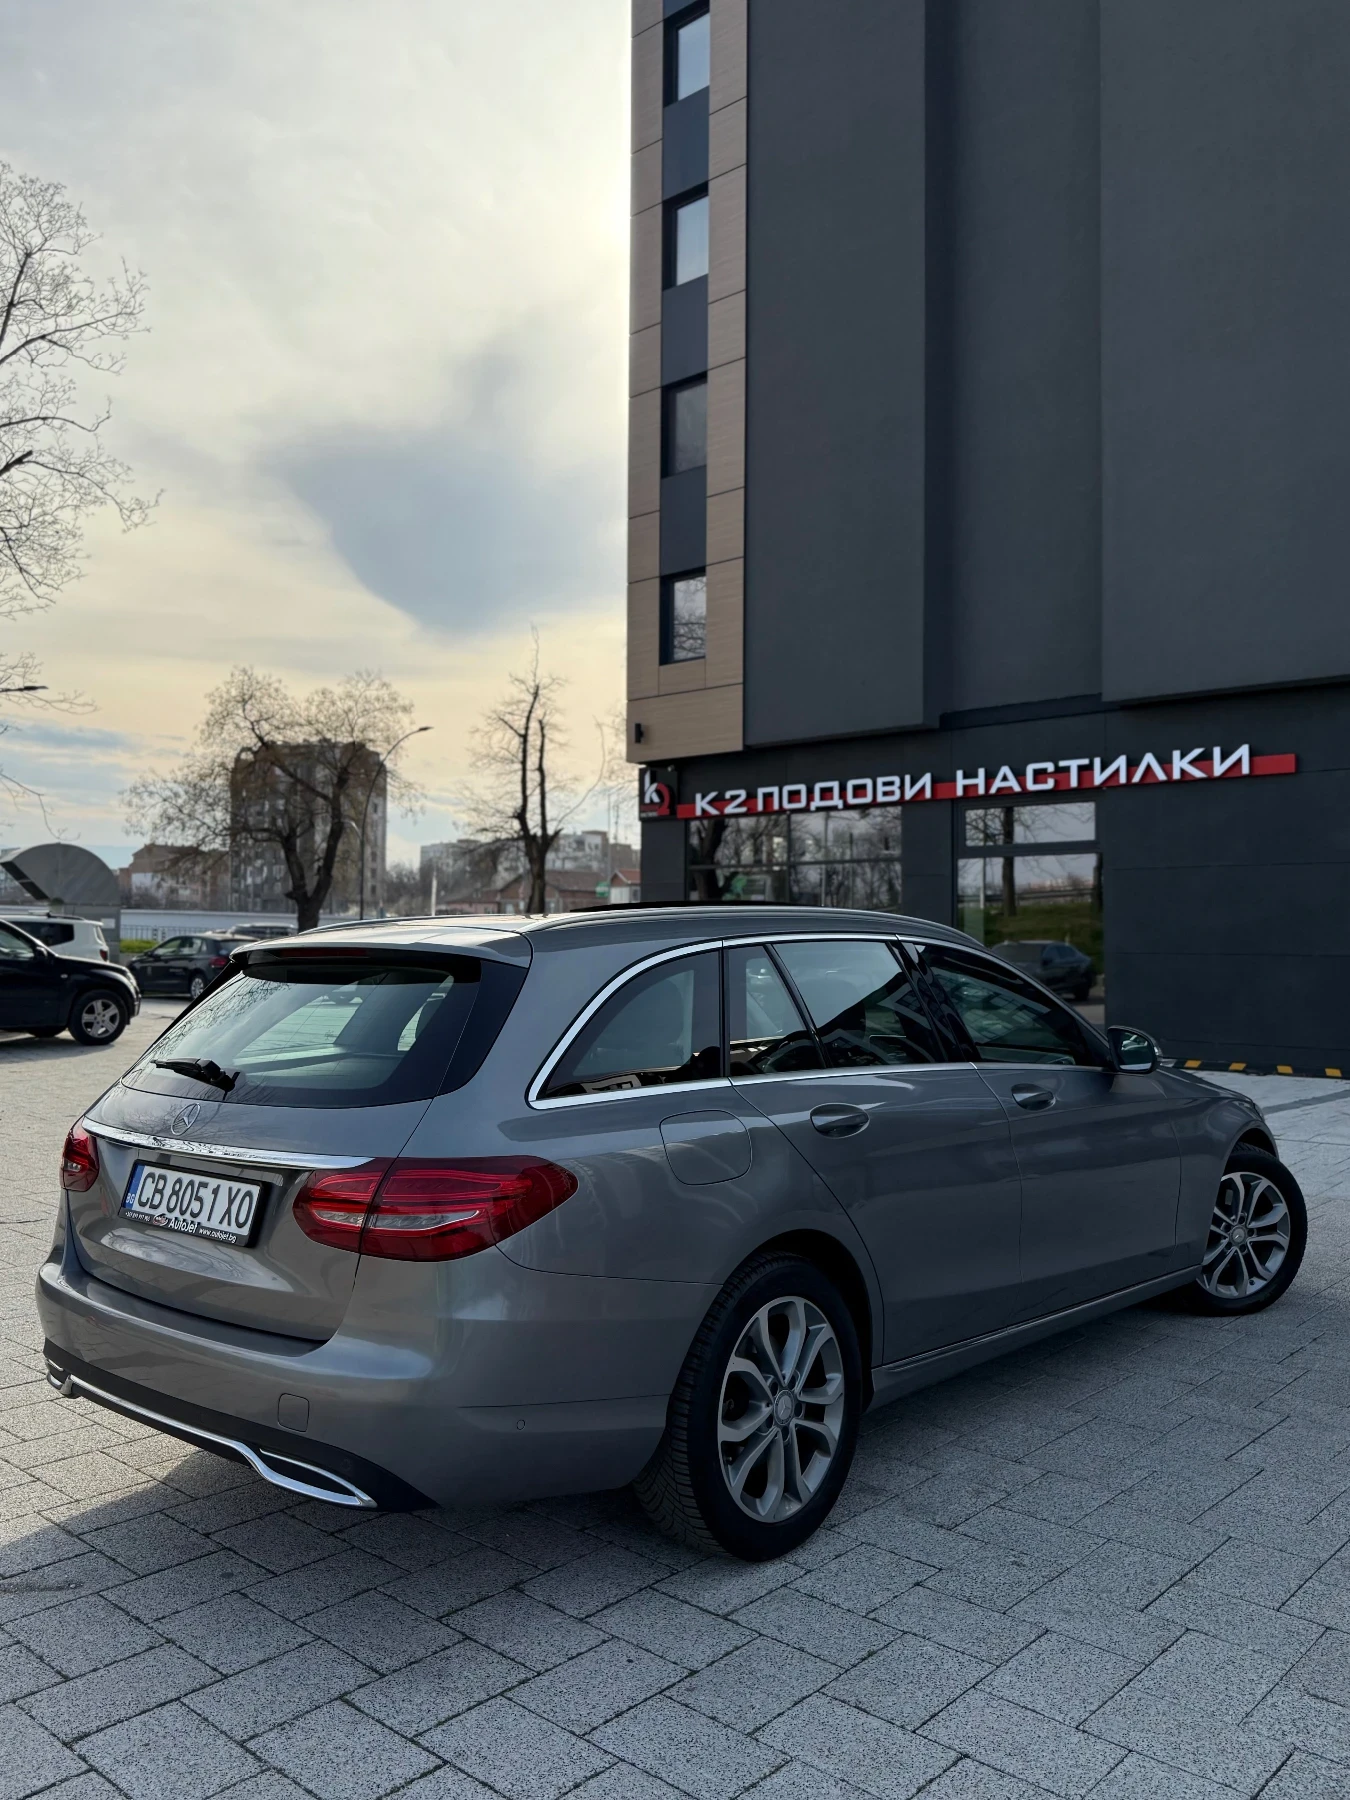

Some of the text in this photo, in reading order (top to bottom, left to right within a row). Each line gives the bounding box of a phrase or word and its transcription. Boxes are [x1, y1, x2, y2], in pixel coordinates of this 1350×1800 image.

[757, 772, 932, 811] ПОДОВИ
[956, 744, 1250, 796] НАСТИЛКИ
[138, 1172, 168, 1209] CB
[166, 1176, 221, 1222] 8051
[198, 1228, 237, 1244] www.autojet.bg
